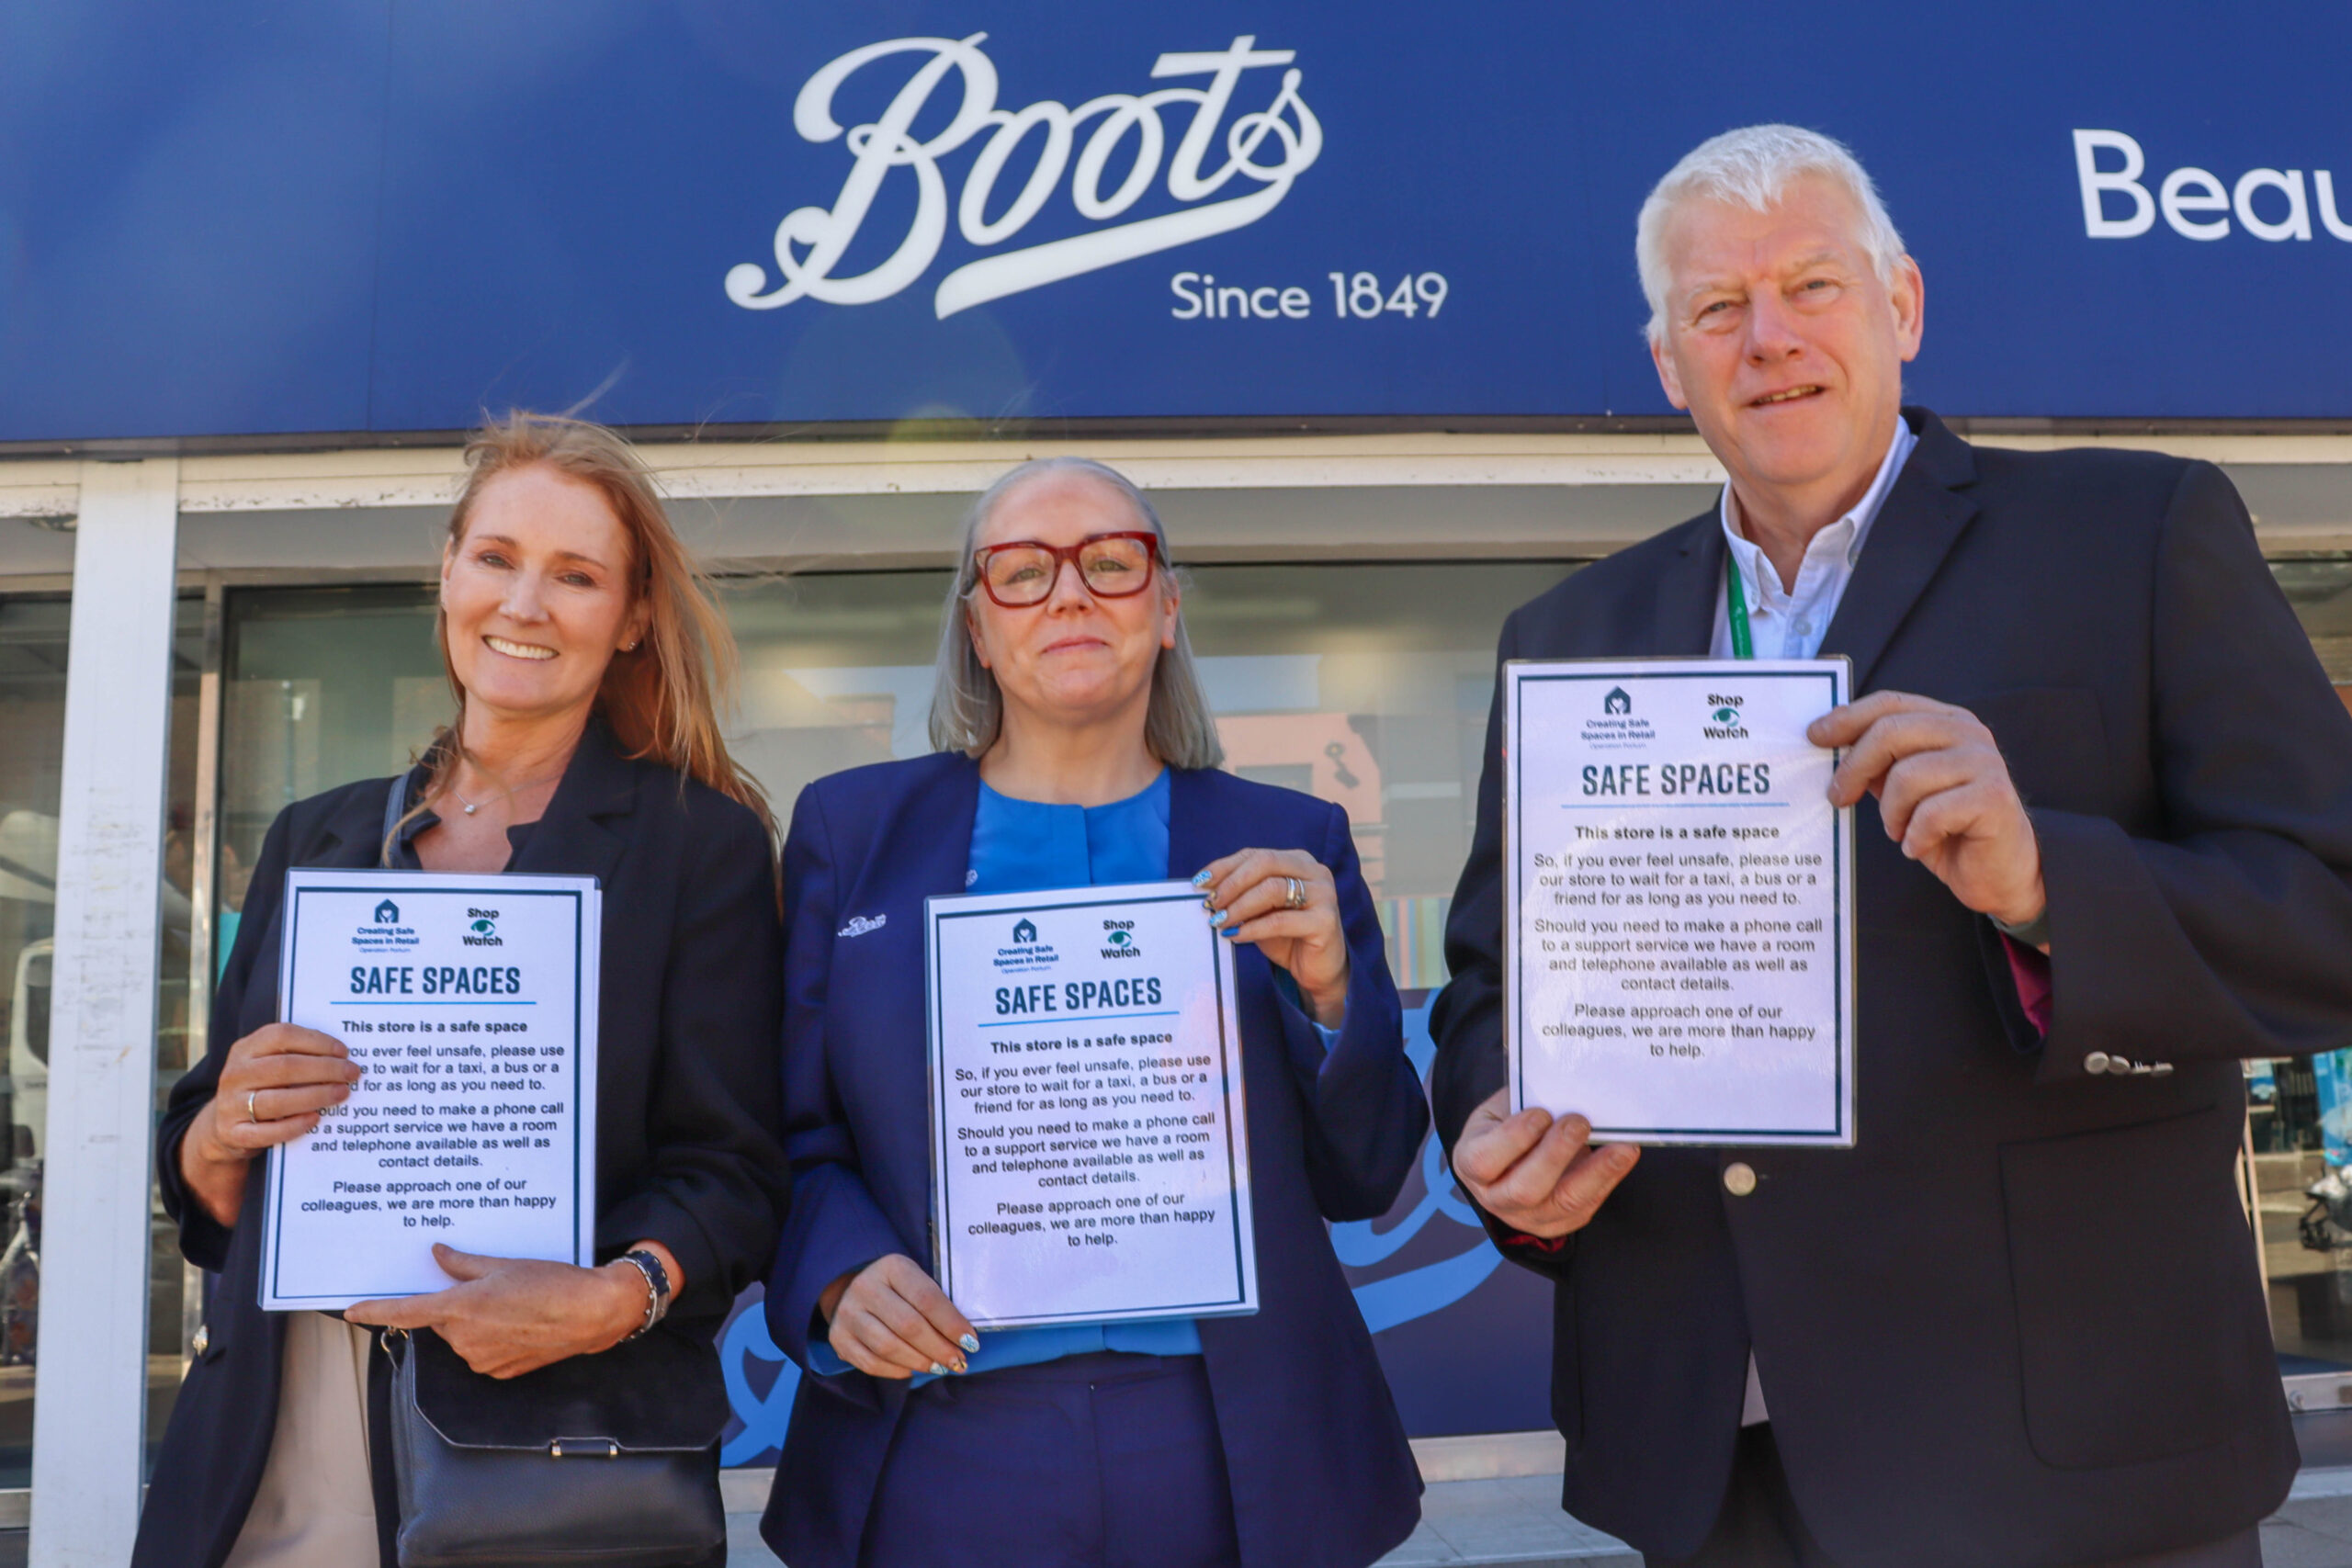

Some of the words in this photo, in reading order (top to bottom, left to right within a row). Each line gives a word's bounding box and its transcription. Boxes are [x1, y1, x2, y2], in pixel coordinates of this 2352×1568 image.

[725, 31, 1323, 320] Boots
[2073, 129, 2352, 243] Beau
[1171, 272, 1310, 319] Since
[1329, 272, 1448, 319] 1849
[1708, 694, 1744, 707] Shop
[1703, 725, 1748, 739] Watch
[1582, 764, 1650, 796] SAFE
[1661, 763, 1770, 795] SPACES
[1575, 826, 1609, 840] This
[1614, 827, 1655, 840] store
[1660, 826, 1674, 839] is
[1679, 828, 1688, 839] a
[1693, 825, 1726, 839] safe
[1732, 828, 1779, 841] space
[467, 908, 500, 920] Shop
[1102, 919, 1135, 931] Shop
[462, 934, 503, 946] Watch
[1542, 939, 1555, 952] to
[1561, 941, 1570, 952] a
[1575, 938, 1631, 954] support
[1635, 937, 1689, 953] service
[1693, 941, 1715, 952] we
[1720, 938, 1757, 952] have
[1762, 941, 1771, 952] a
[1776, 941, 1815, 952] room
[998, 947, 1034, 956] Creating
[1035, 944, 1054, 953] Safe
[1101, 945, 1141, 959] Watch
[993, 958, 1024, 966] Spaces
[1025, 954, 1034, 964] in
[1035, 954, 1058, 963] Retail
[1549, 957, 1577, 971] and
[1581, 957, 1656, 974] telephone
[1660, 956, 1727, 972] available
[1732, 960, 1750, 972] as
[1755, 957, 1784, 971] well
[1790, 960, 1808, 972] as
[350, 966, 413, 994] SAFE
[423, 966, 520, 995] SPACES
[1621, 976, 1676, 991] contact
[1679, 976, 1734, 991] details.
[995, 984, 1057, 1015] SAFE
[1065, 976, 1161, 1010] SPACES
[1575, 1003, 1625, 1018] Please
[1630, 1004, 1700, 1021] approach
[1705, 1007, 1734, 1019] one
[1738, 1004, 1754, 1019] of
[1758, 1007, 1782, 1019] our
[342, 1021, 373, 1032] This
[378, 1021, 415, 1032] store
[420, 1021, 433, 1032] is
[436, 1023, 446, 1032] a
[450, 1021, 481, 1032] safe
[485, 1022, 527, 1035] space
[1543, 1021, 1626, 1040] colleagues,
[1632, 1026, 1653, 1037] we
[1658, 1026, 1683, 1037] are
[1688, 1025, 1725, 1038] more
[1731, 1023, 1764, 1038] than
[1770, 1023, 1815, 1042] happy
[372, 1047, 402, 1057] ever
[406, 1044, 432, 1057] feel
[436, 1044, 486, 1058] unsafe,
[491, 1044, 537, 1059] please
[540, 1046, 565, 1056] use
[990, 1041, 1022, 1054] This
[1025, 1040, 1062, 1052] store
[1067, 1037, 1079, 1049] is
[1083, 1038, 1091, 1048] a
[1096, 1033, 1125, 1047] safe
[1130, 1033, 1172, 1047] space
[1650, 1043, 1664, 1056] to
[1669, 1043, 1704, 1059] help.
[956, 1068, 978, 1082] So,
[981, 1066, 990, 1079] if
[993, 1067, 1018, 1081] you
[1023, 1065, 1052, 1077] ever
[1056, 1061, 1080, 1074] feel
[1084, 1058, 1134, 1073] unsafe,
[1138, 1056, 1182, 1072] please
[1187, 1055, 1211, 1066] use
[960, 1087, 983, 1099] our
[987, 1084, 1021, 1096] store
[1024, 1082, 1037, 1093] to
[1041, 1079, 1069, 1092] wait
[1072, 1077, 1091, 1090] for
[1095, 1079, 1103, 1089] a
[1107, 1075, 1136, 1089] taxi,
[1140, 1077, 1148, 1087] a
[1152, 1073, 1177, 1086] bus
[1181, 1074, 1194, 1084] or
[1199, 1073, 1207, 1083] a
[316, 1105, 348, 1117] ould
[353, 1107, 378, 1119] you
[382, 1104, 417, 1116] need
[421, 1104, 435, 1116] to
[439, 1103, 477, 1115] make
[481, 1105, 490, 1115] a
[493, 1102, 537, 1117] phone
[540, 1101, 564, 1114] call
[974, 1100, 1012, 1114] friend
[1016, 1099, 1035, 1111] for
[1038, 1100, 1055, 1110] as
[1058, 1096, 1088, 1111] long
[1091, 1096, 1108, 1107] as
[1112, 1095, 1136, 1108] you
[1141, 1089, 1174, 1103] need
[1178, 1089, 1194, 1101] to.
[957, 1124, 1004, 1141] Should
[1009, 1126, 1033, 1139] you
[1037, 1121, 1070, 1134] need
[1075, 1121, 1088, 1133] to
[1091, 1118, 1129, 1132] make
[1134, 1119, 1142, 1129] a
[1147, 1115, 1188, 1131] phone
[1192, 1111, 1216, 1125] call
[311, 1139, 338, 1152] and
[343, 1139, 412, 1153] telephone
[415, 1137, 478, 1150] available
[481, 1139, 499, 1149] as
[503, 1136, 529, 1148] well
[534, 1138, 550, 1148] as
[379, 1156, 429, 1168] contact
[434, 1155, 482, 1167] details.
[333, 1180, 382, 1193] Please
[386, 1179, 451, 1195] approach
[456, 1181, 482, 1191] one
[486, 1178, 501, 1190] of
[503, 1179, 527, 1190] our
[301, 1199, 382, 1213] colleagues,
[387, 1200, 407, 1210] we
[412, 1200, 435, 1210] are
[439, 1199, 475, 1209] more
[479, 1196, 510, 1208] than
[514, 1195, 557, 1209] happy
[402, 1215, 417, 1227] to
[421, 1214, 455, 1229] help.
